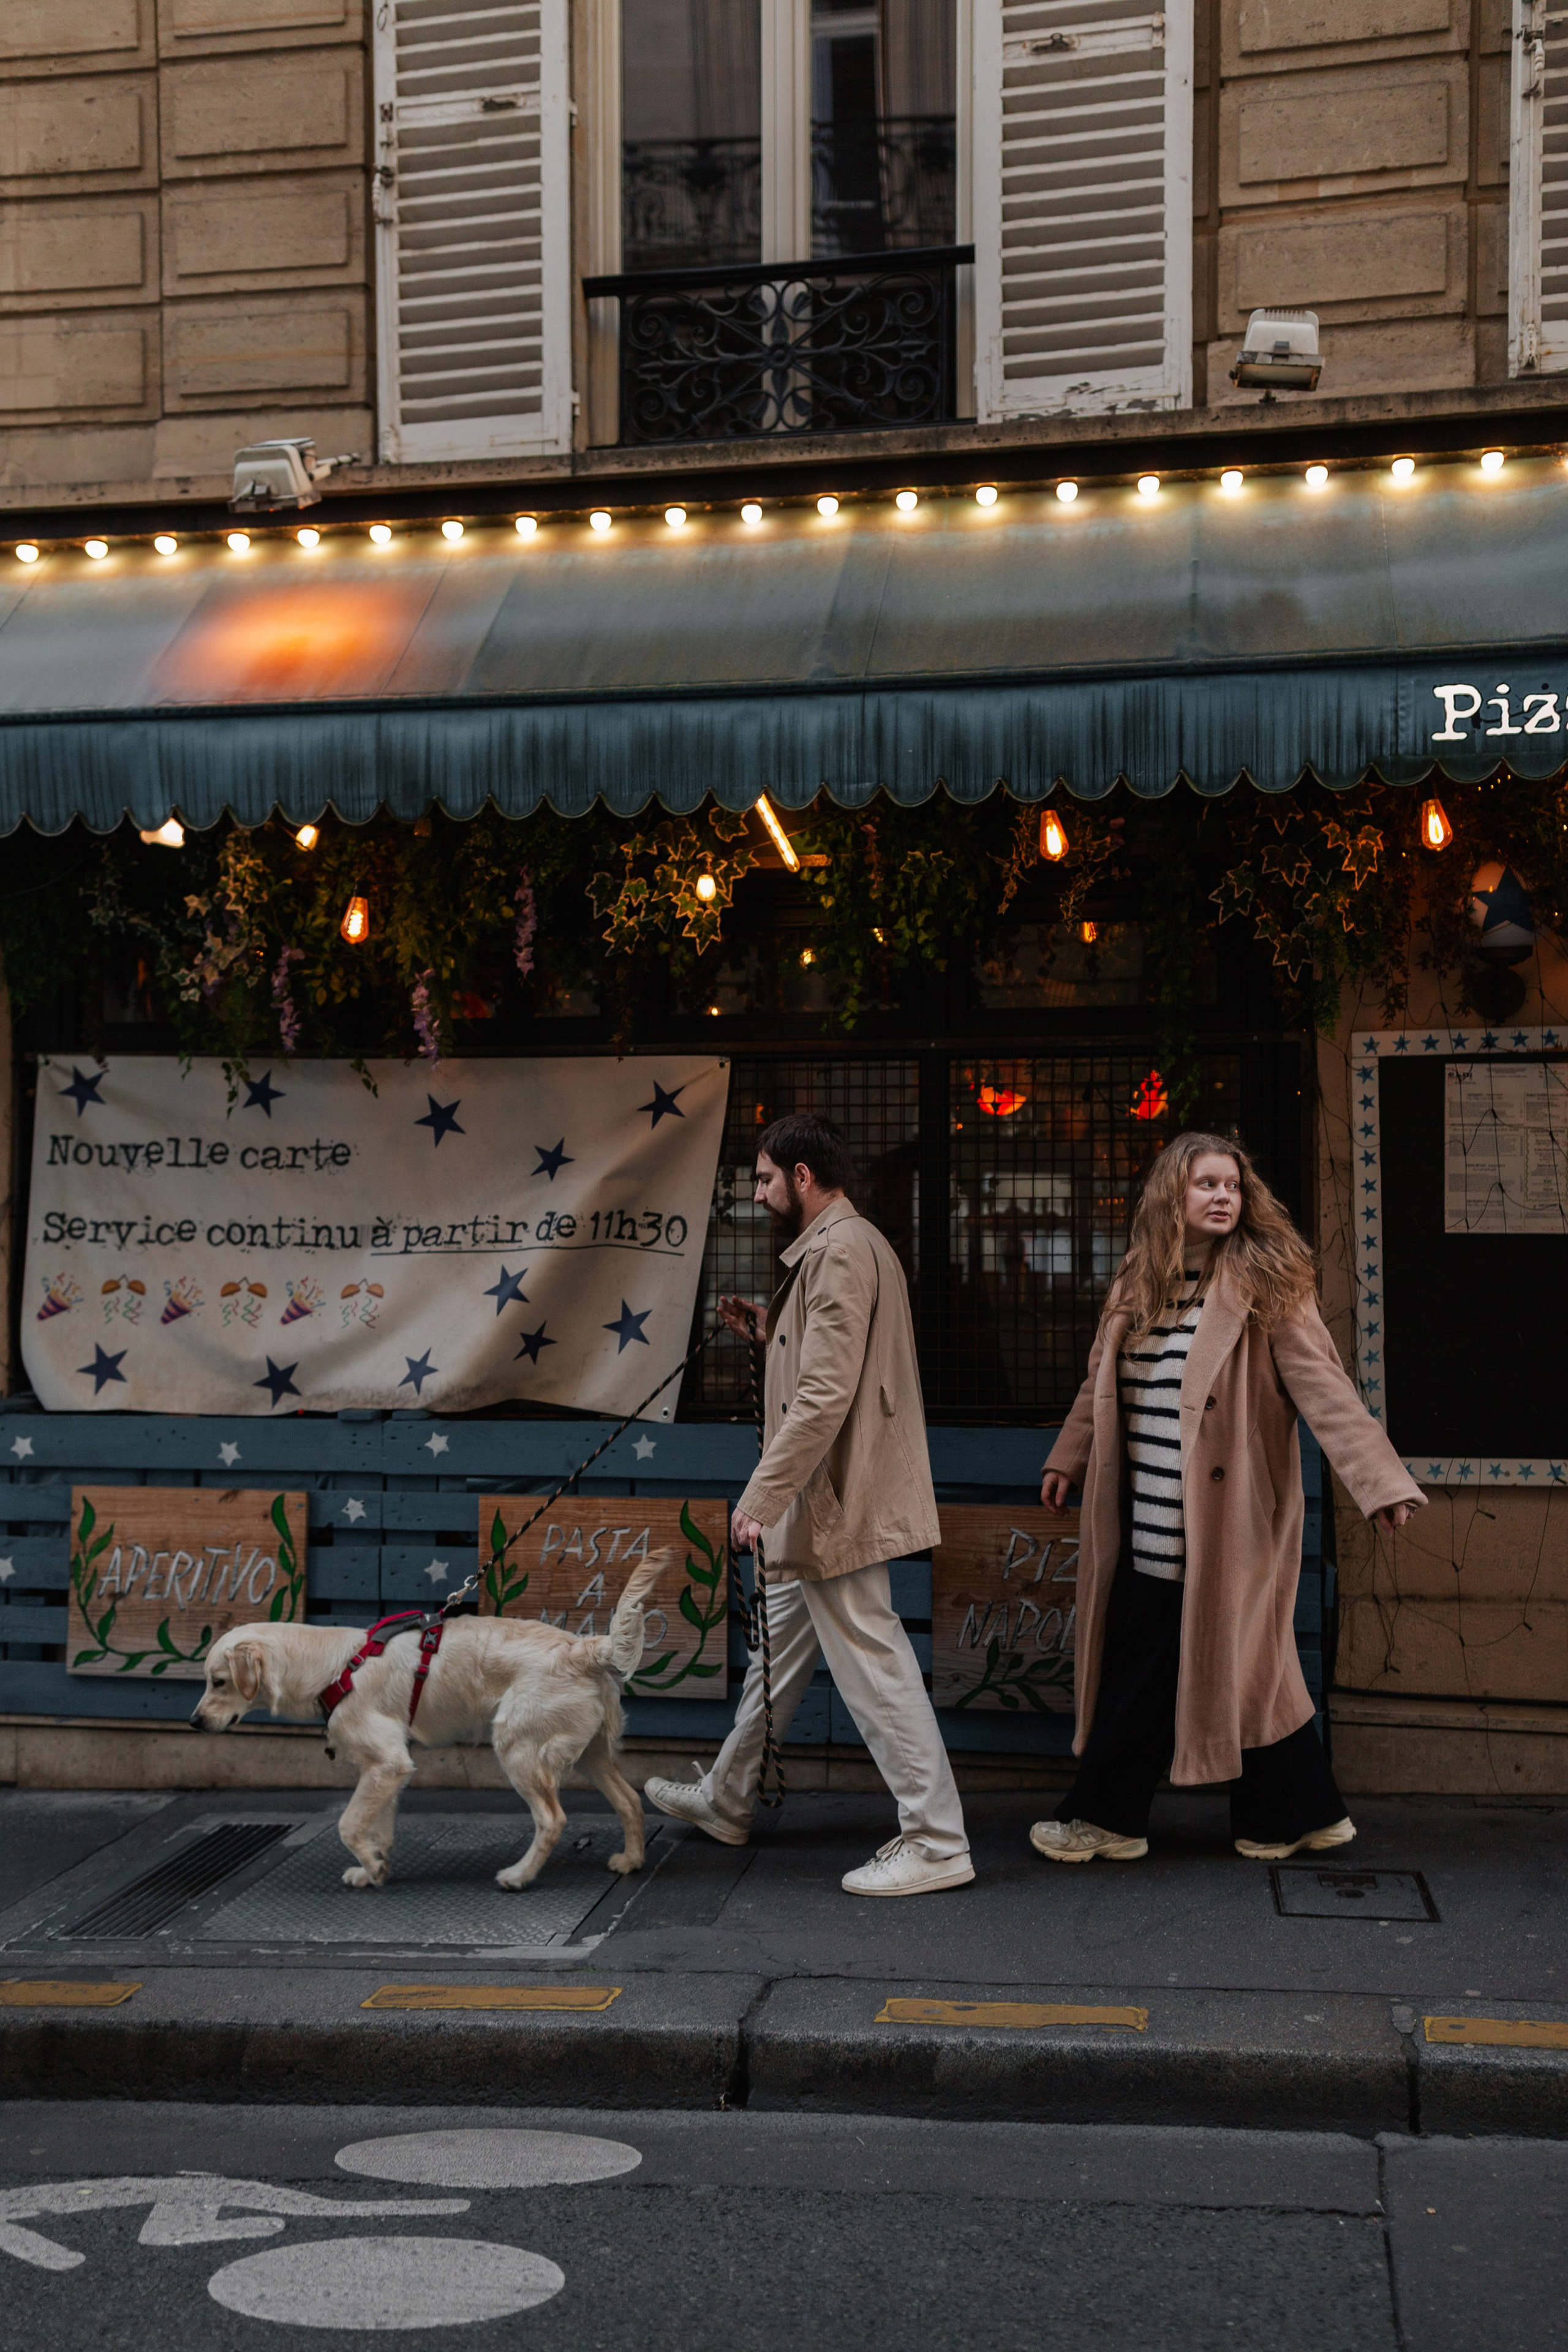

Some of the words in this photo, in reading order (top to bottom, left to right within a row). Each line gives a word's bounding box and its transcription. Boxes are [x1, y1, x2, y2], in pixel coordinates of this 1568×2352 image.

[1431, 684, 1568, 741] Piz
[46, 1134, 230, 1169] Nouvelle
[239, 1139, 352, 1170] carte
[42, 1212, 197, 1247] Service
[206, 1216, 363, 1248] continu
[370, 1218, 393, 1248] à
[402, 1215, 529, 1254] partir
[534, 1212, 577, 1246] de
[590, 1209, 688, 1248] 11h30
[539, 1524, 652, 1569] PASTA
[97, 1541, 277, 1611] APERITIVO
[576, 1570, 608, 1608] A
